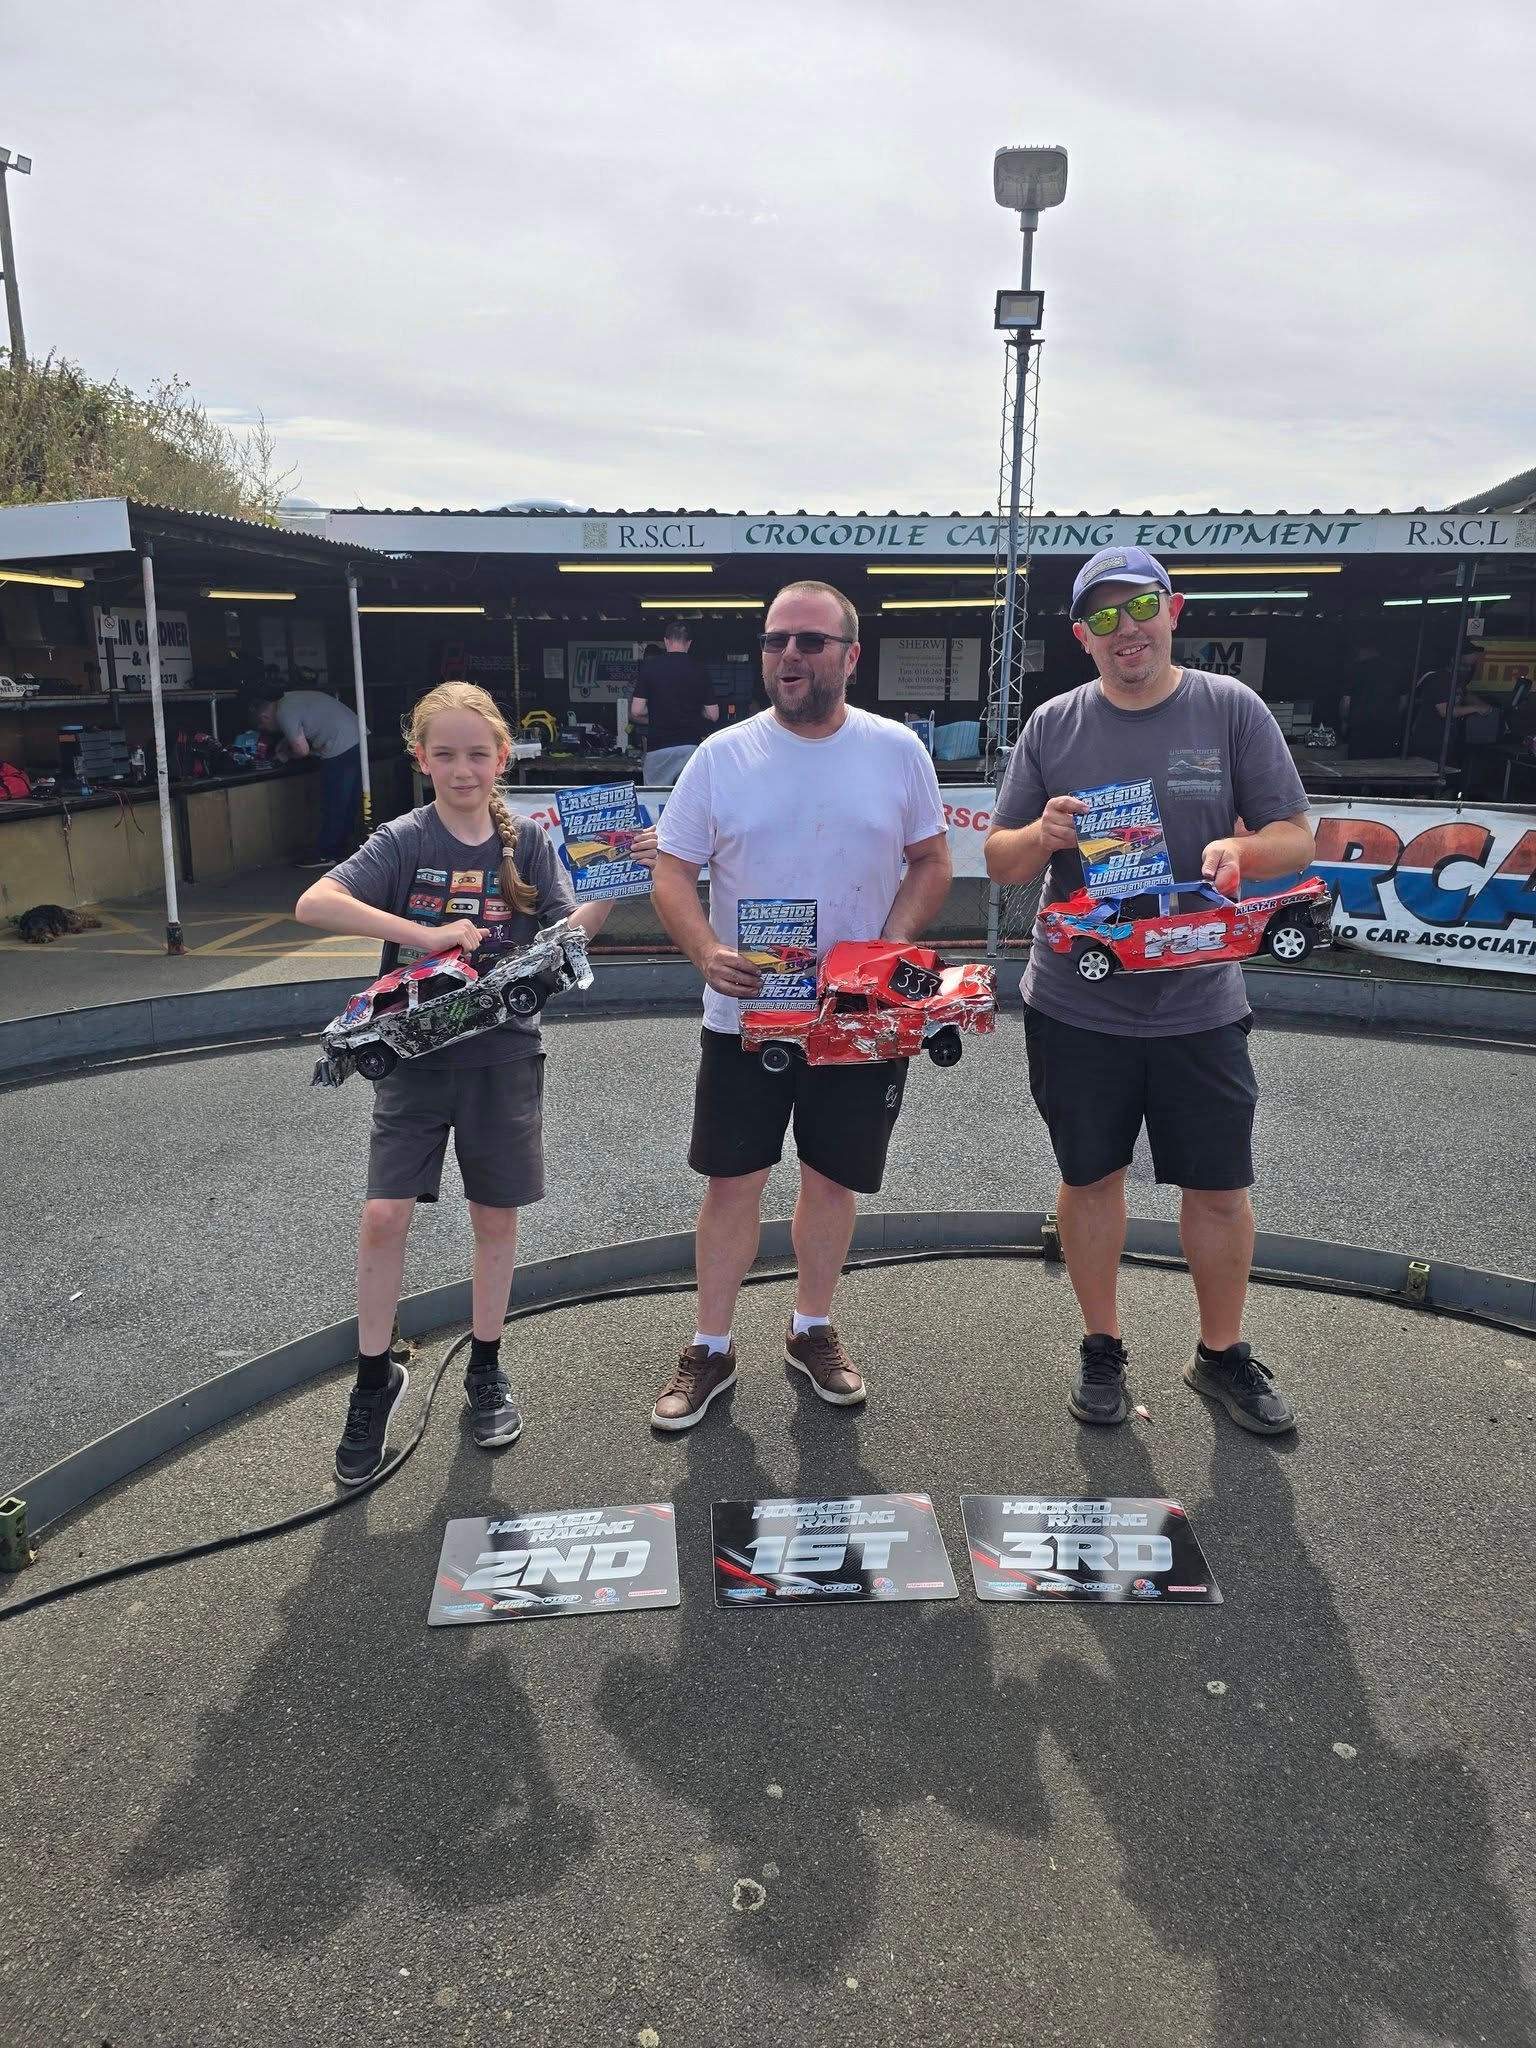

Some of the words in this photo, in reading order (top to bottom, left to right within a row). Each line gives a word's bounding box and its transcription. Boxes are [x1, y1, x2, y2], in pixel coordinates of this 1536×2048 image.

[618, 524, 705, 548] R.S.C.L
[745, 523, 929, 546] CROCODILE
[946, 523, 1114, 547] CATERING
[1135, 521, 1362, 549] EQUIPMENT
[1405, 520, 1509, 546] R.S.C.L
[135, 620, 190, 648] GDNER
[132, 650, 142, 666] &
[560, 786, 635, 812] LAKESIDE
[1081, 784, 1152, 808] AKESIDE
[586, 808, 635, 824] ALLOY
[1099, 803, 1153, 822] ALLOY
[568, 817, 637, 836] BANGERS
[1080, 812, 1154, 834] BANGERS
[586, 861, 633, 878] BEST
[1089, 861, 1165, 886] WINNER
[1300, 818, 1536, 931] RCA
[576, 869, 650, 891] WRECKER
[580, 889, 613, 902] SATURDAY
[628, 883, 654, 894] AUGUST
[1090, 885, 1127, 898] SATURDAY
[740, 905, 816, 920] LAKESIDE
[742, 935, 813, 944] BANGERS
[763, 925, 814, 935] ALLOY
[1366, 927, 1410, 943] CAR
[761, 973, 806, 985] EST
[760, 986, 812, 998] RECK
[740, 1002, 774, 1010] SATURDAY
[789, 1002, 816, 1010] AUGUST
[751, 1500, 862, 1520] HOOKED
[1002, 1501, 1112, 1515] HOOKED
[486, 1511, 603, 1535] HOOKED
[795, 1510, 895, 1529] RACING
[1047, 1513, 1148, 1527] RACING
[529, 1519, 636, 1543] RACING
[744, 1531, 909, 1575] 1ST
[999, 1531, 1173, 1572] 3RD
[461, 1540, 651, 1592] 2ND
